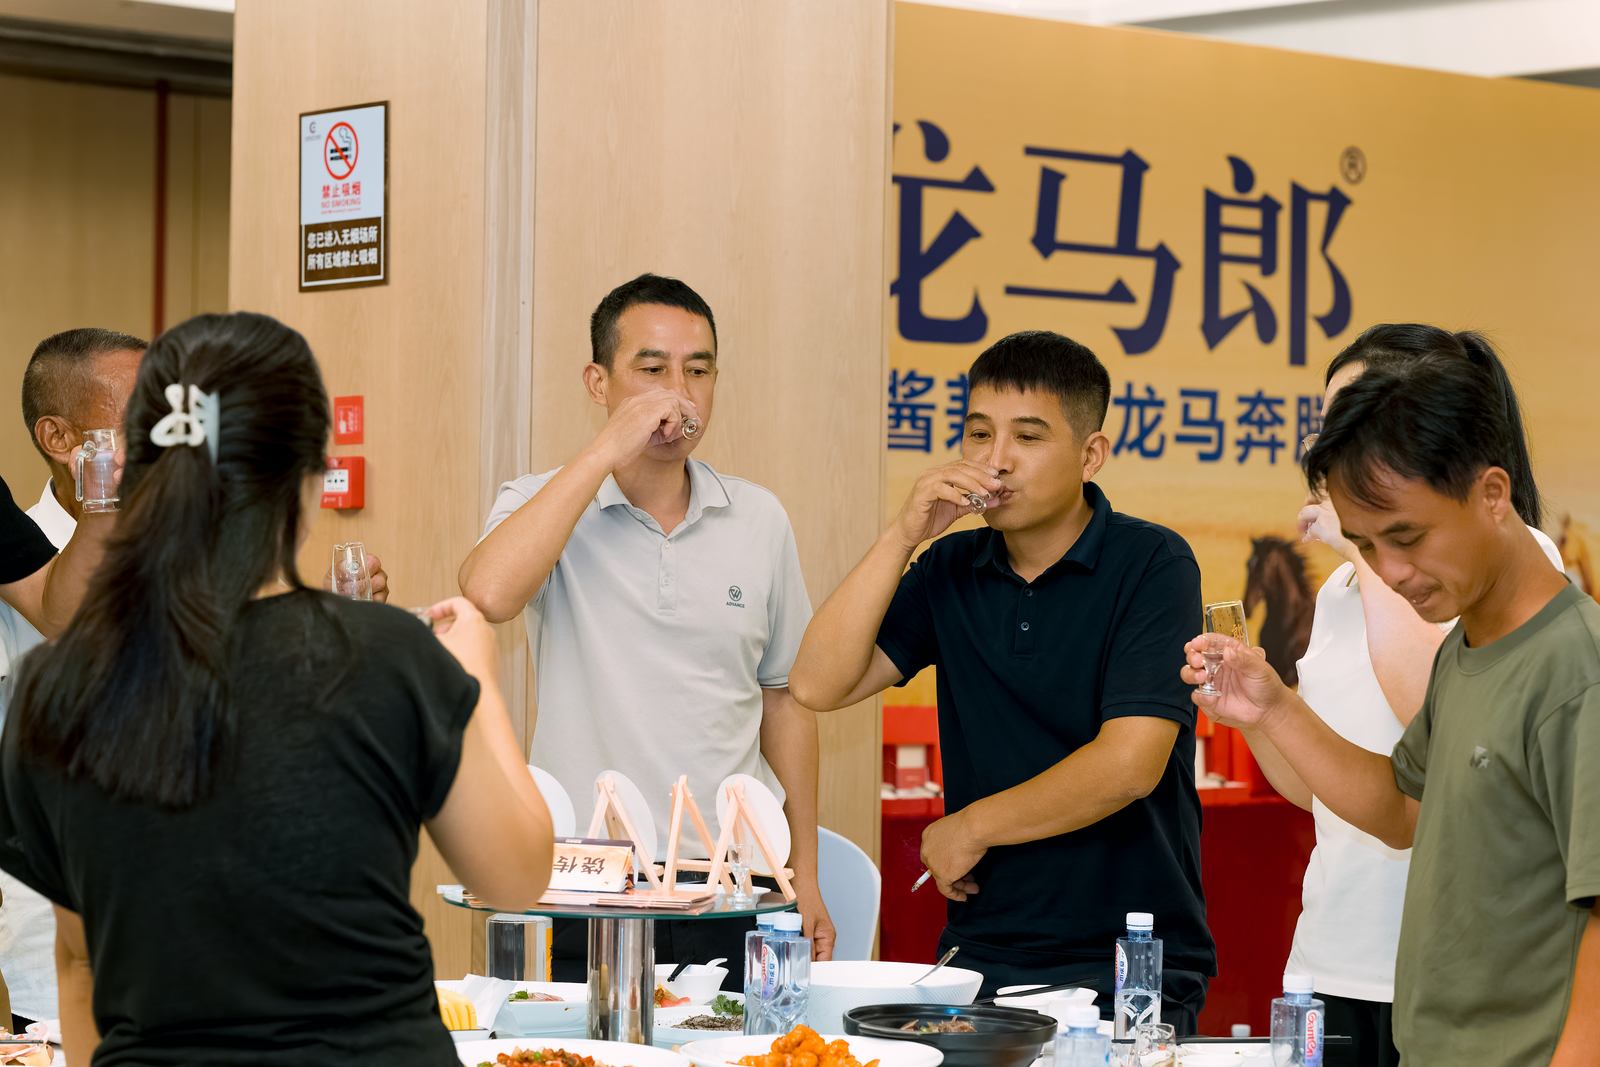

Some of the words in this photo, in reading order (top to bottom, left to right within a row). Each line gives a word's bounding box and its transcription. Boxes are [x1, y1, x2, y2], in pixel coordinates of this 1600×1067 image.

[322, 181, 361, 198] 禁止吸烟
[307, 226, 378, 249] 您已进入无烟场所
[891, 120, 1354, 367] 龙马郎
[307, 248, 378, 270] 所有区域禁止吸烟
